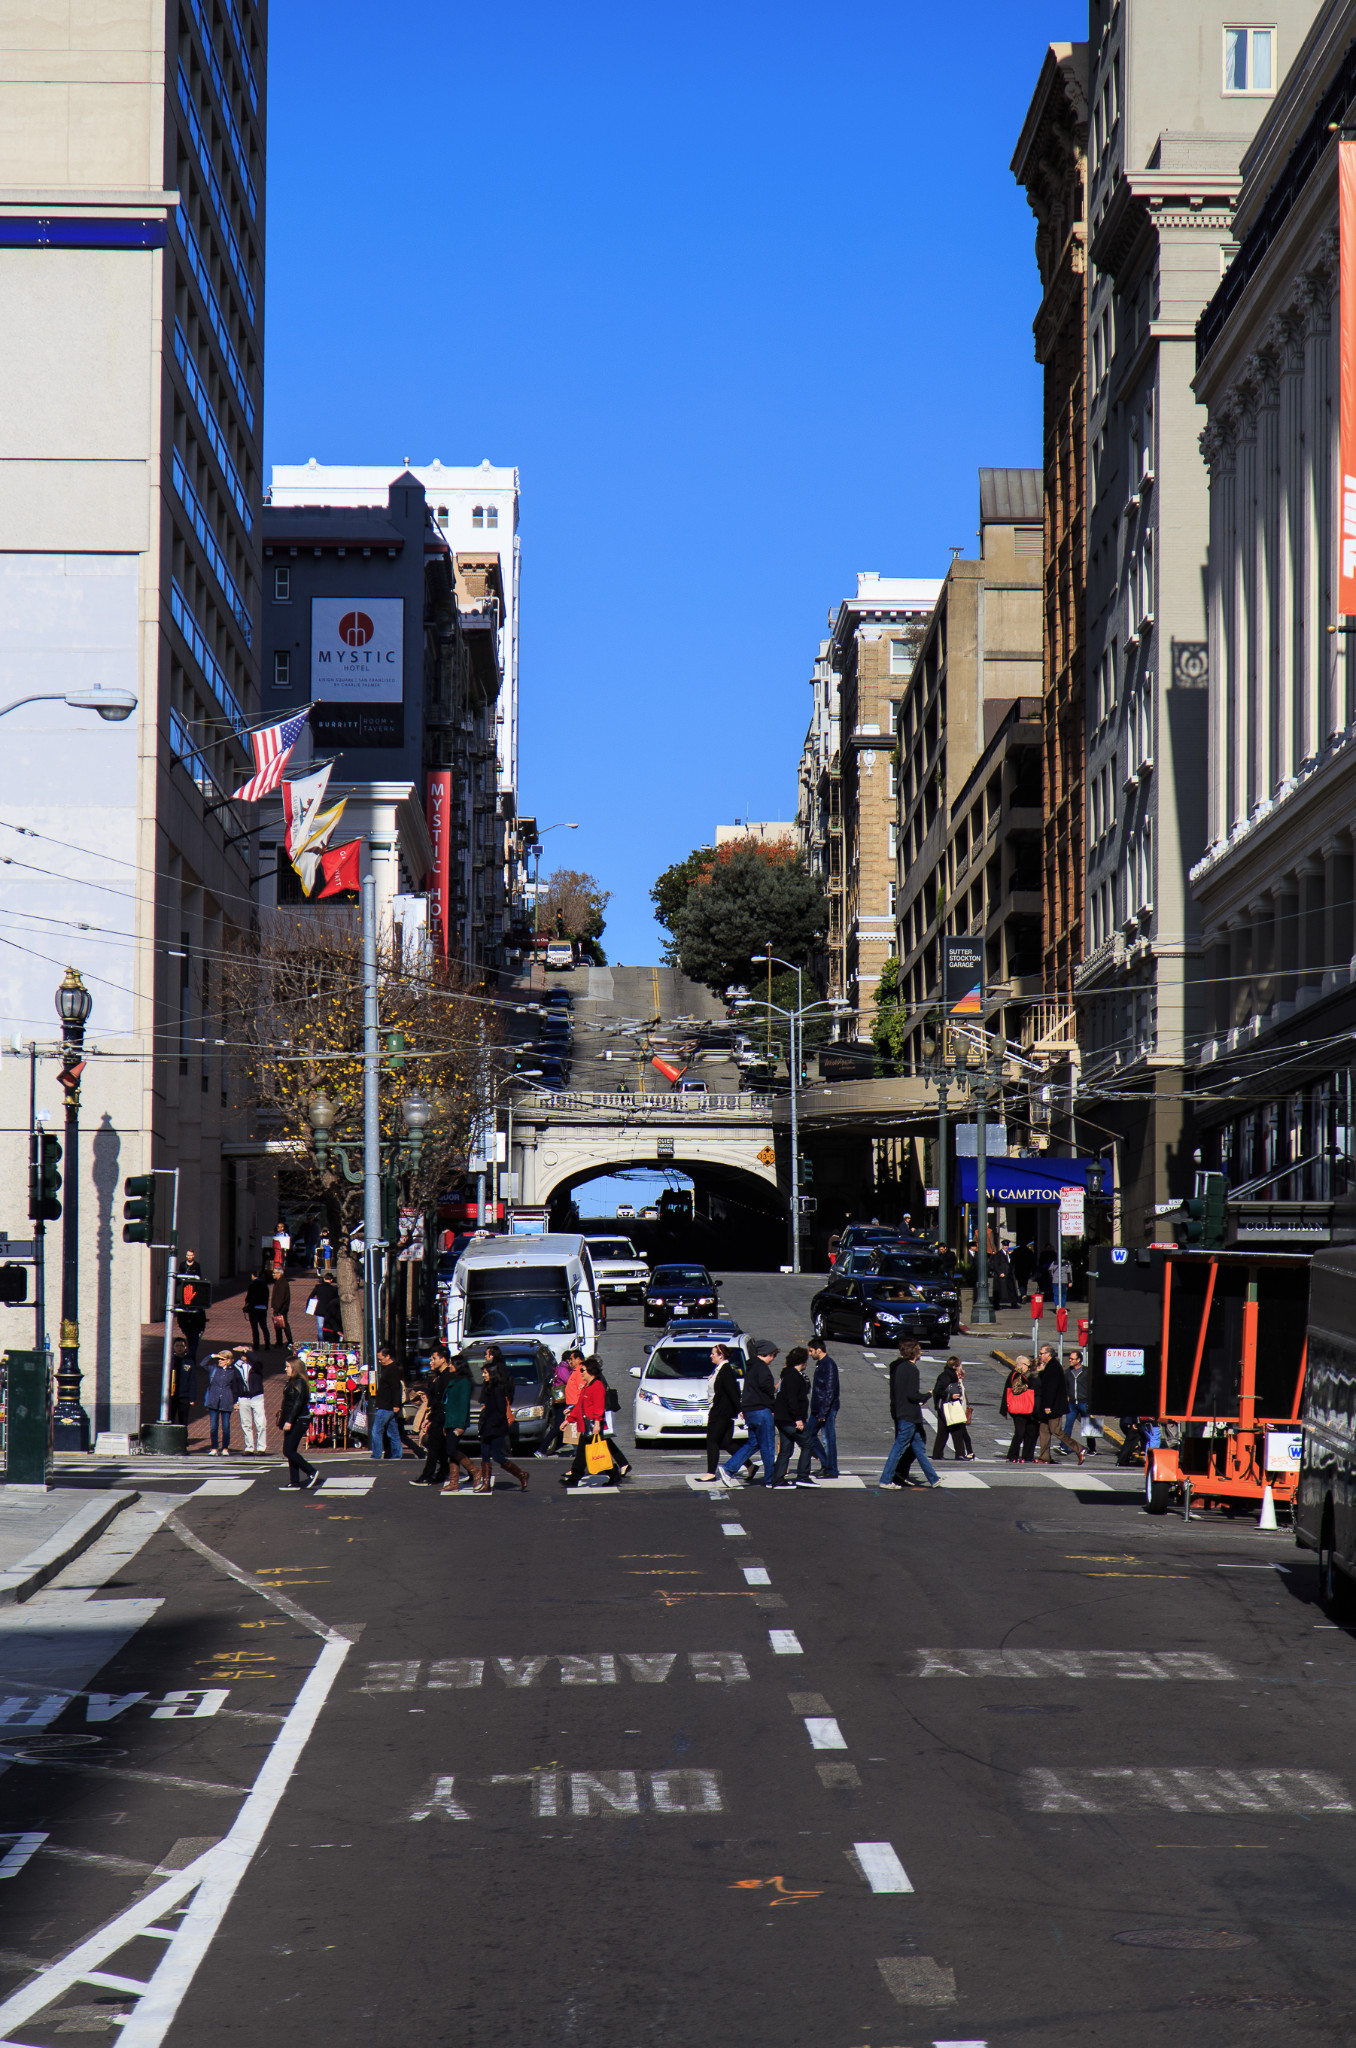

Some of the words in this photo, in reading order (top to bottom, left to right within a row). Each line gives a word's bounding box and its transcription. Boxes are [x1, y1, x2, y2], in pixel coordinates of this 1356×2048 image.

[318, 650, 395, 663] MYSTIC
[318, 720, 359, 728] BURRITT
[430, 783, 445, 874] MYSTIC
[998, 1188, 1062, 1201] CAMPTON
[1246, 1221, 1282, 1232] COLE
[1287, 1221, 1324, 1232] HAAN
[1107, 1350, 1142, 1358] SYNERGY
[357, 1651, 752, 1694] GARAGE
[406, 1768, 725, 1822] ONLY
[1020, 1766, 1355, 1815] ONLY
